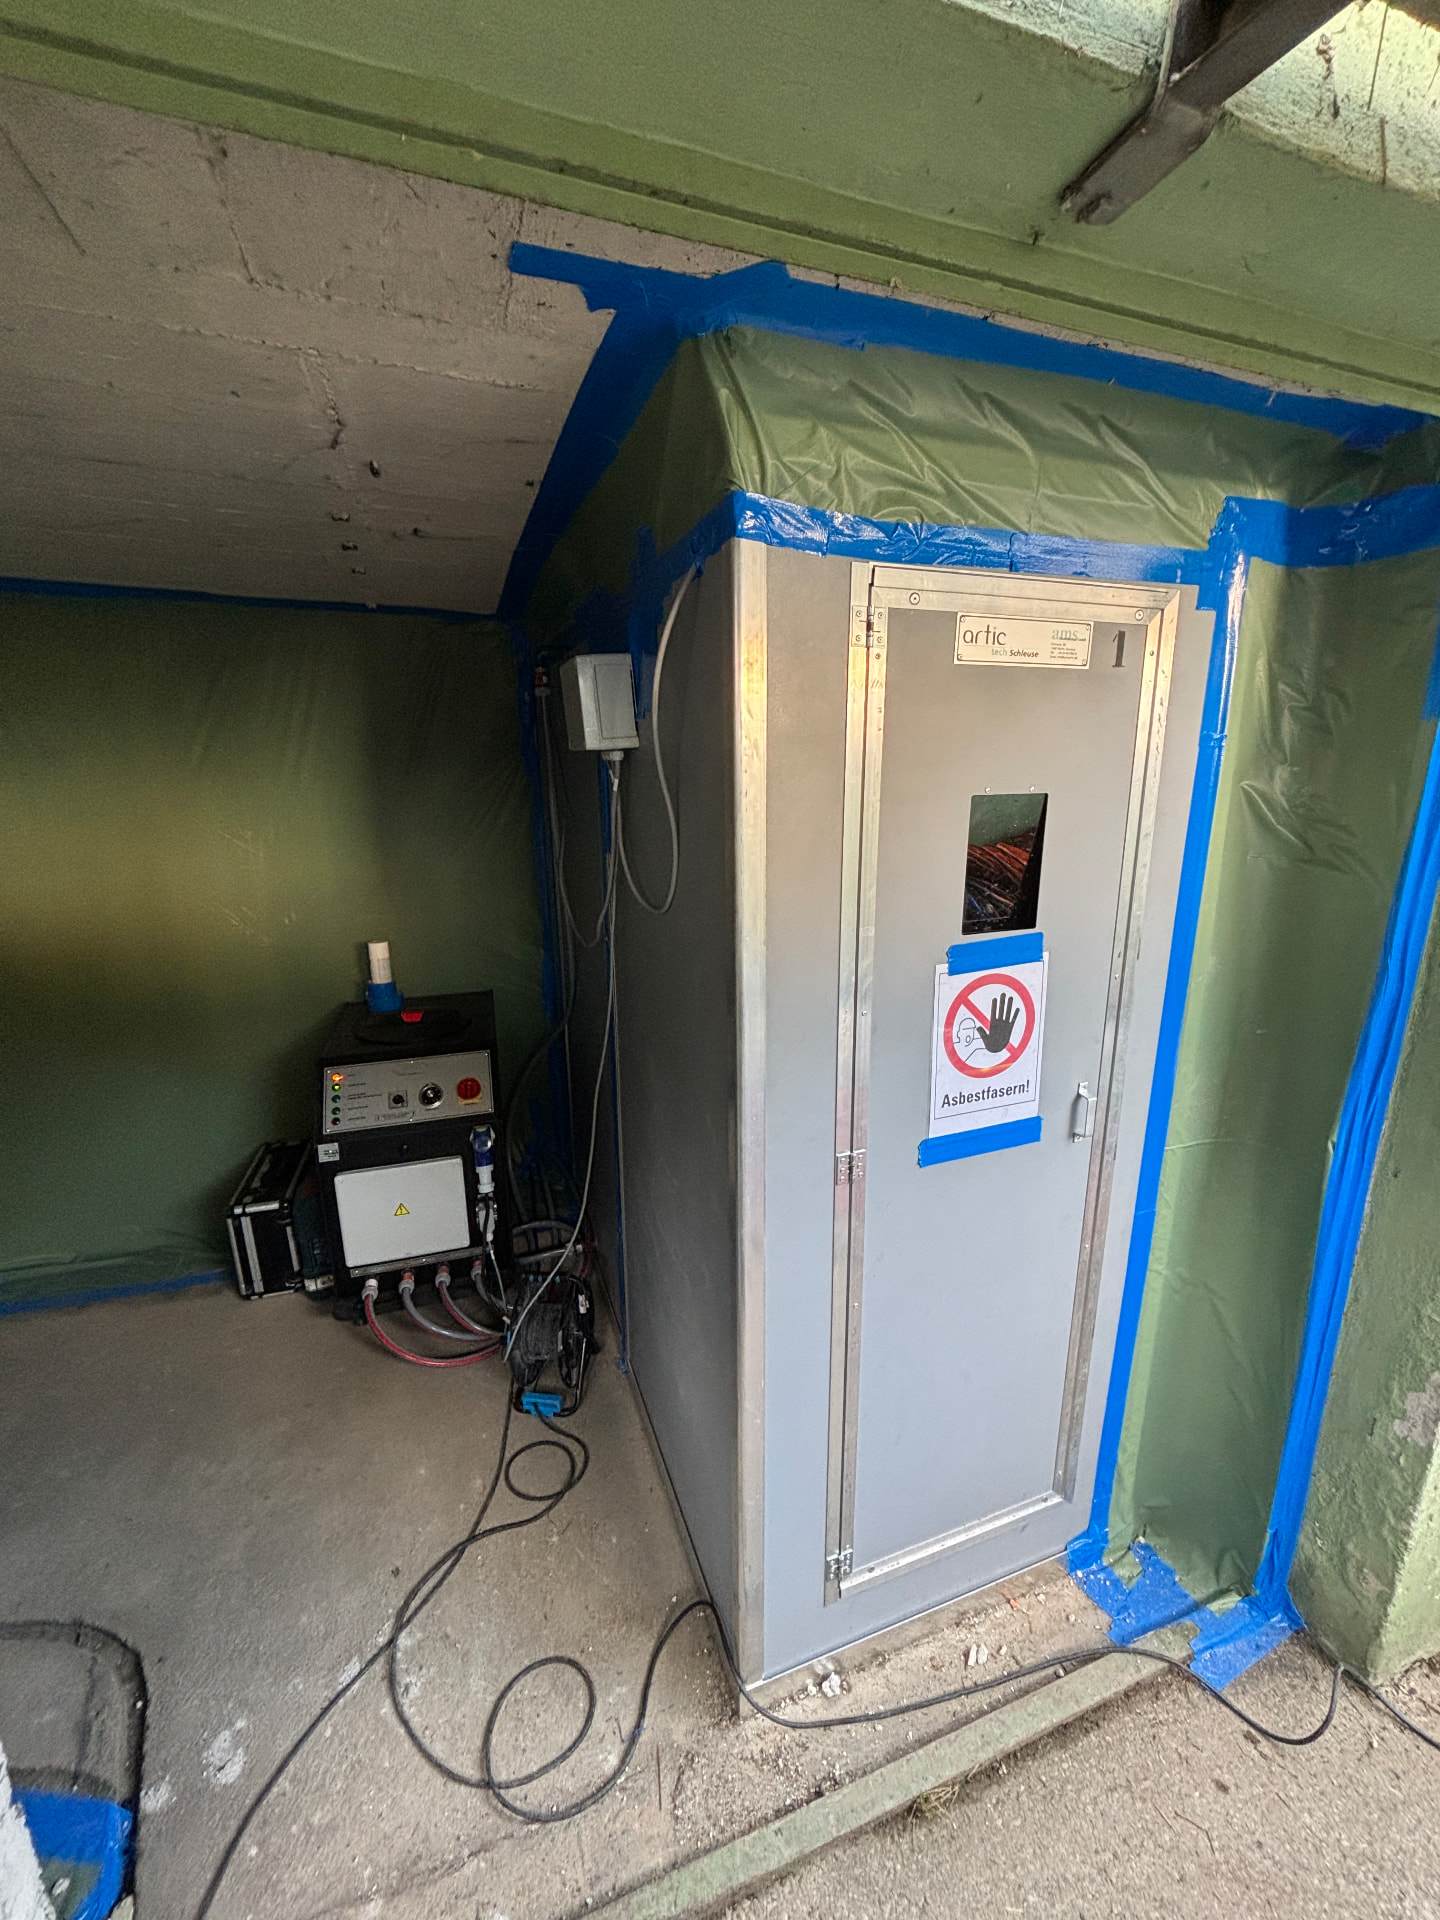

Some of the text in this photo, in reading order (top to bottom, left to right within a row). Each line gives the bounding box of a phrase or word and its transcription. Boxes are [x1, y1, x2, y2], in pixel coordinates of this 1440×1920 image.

[963, 624, 1007, 646] artic
[1052, 629, 1079, 641] ams
[991, 647, 1008, 657] tech
[1009, 649, 1039, 658] Schleuse
[1112, 629, 1126, 668] 1
[941, 1079, 1030, 1108] Asbestfasern!
